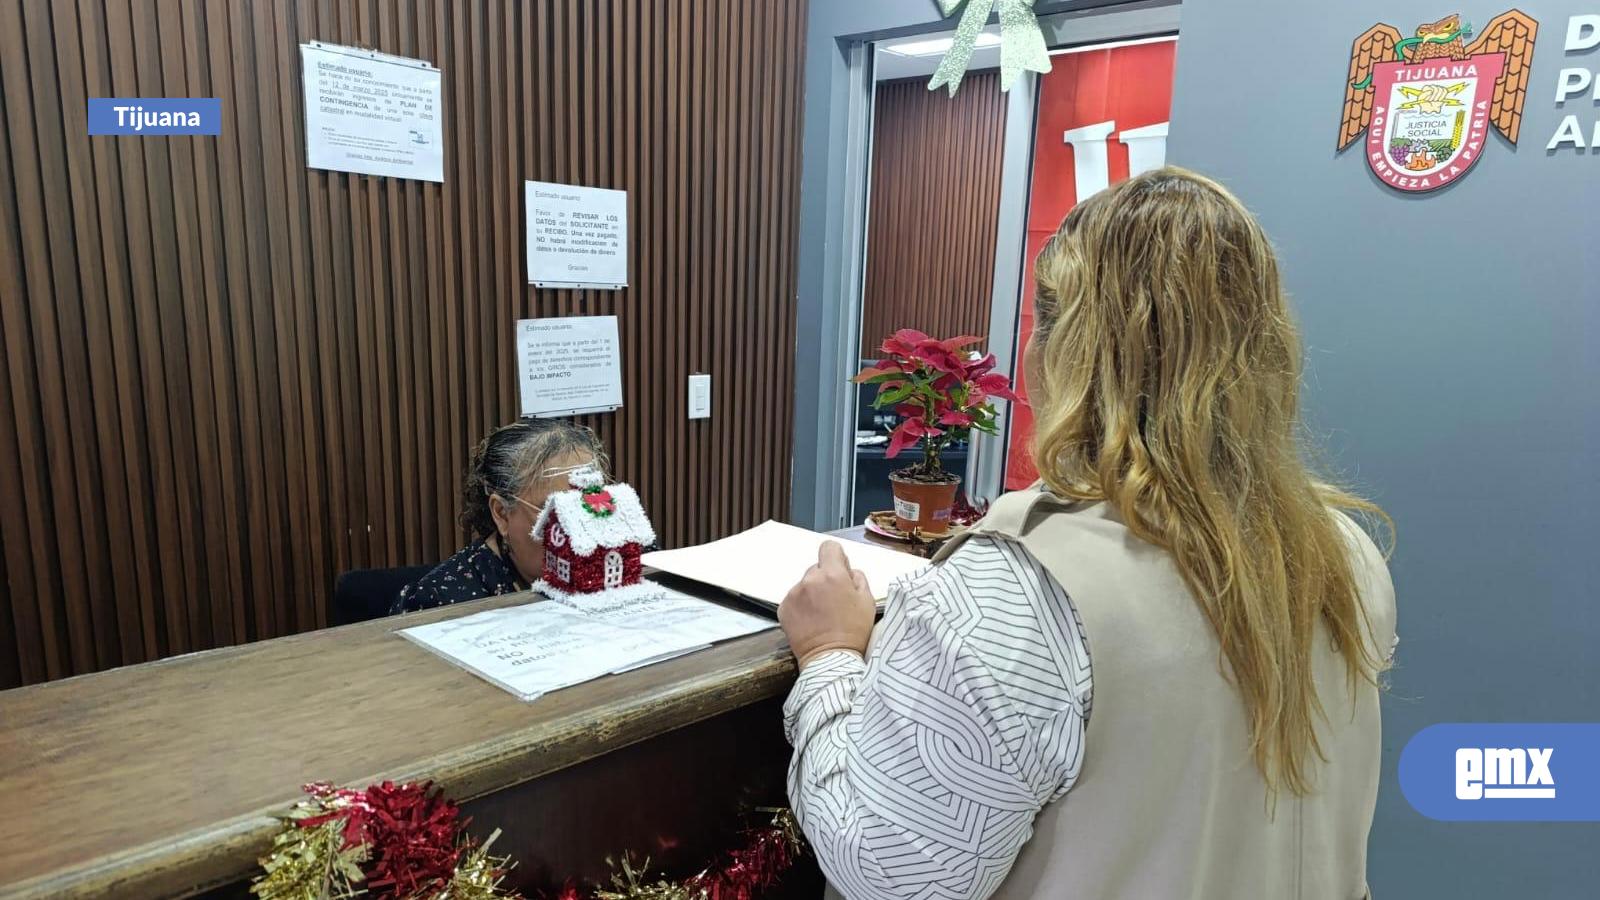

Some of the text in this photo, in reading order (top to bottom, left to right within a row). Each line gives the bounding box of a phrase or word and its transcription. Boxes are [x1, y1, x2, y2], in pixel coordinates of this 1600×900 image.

[1395, 64, 1477, 80] TIJUANA
[319, 96, 368, 110] CONTINGENCIA
[400, 100, 416, 108] PLAN
[1406, 120, 1447, 129] JUSTICIA
[1408, 129, 1442, 138] SOCIAL
[1372, 100, 1487, 188] AQUI EMPIEZA LA PATRIA
[572, 212, 599, 220] REVISAR
[570, 221, 608, 229] SOLICITANTE
